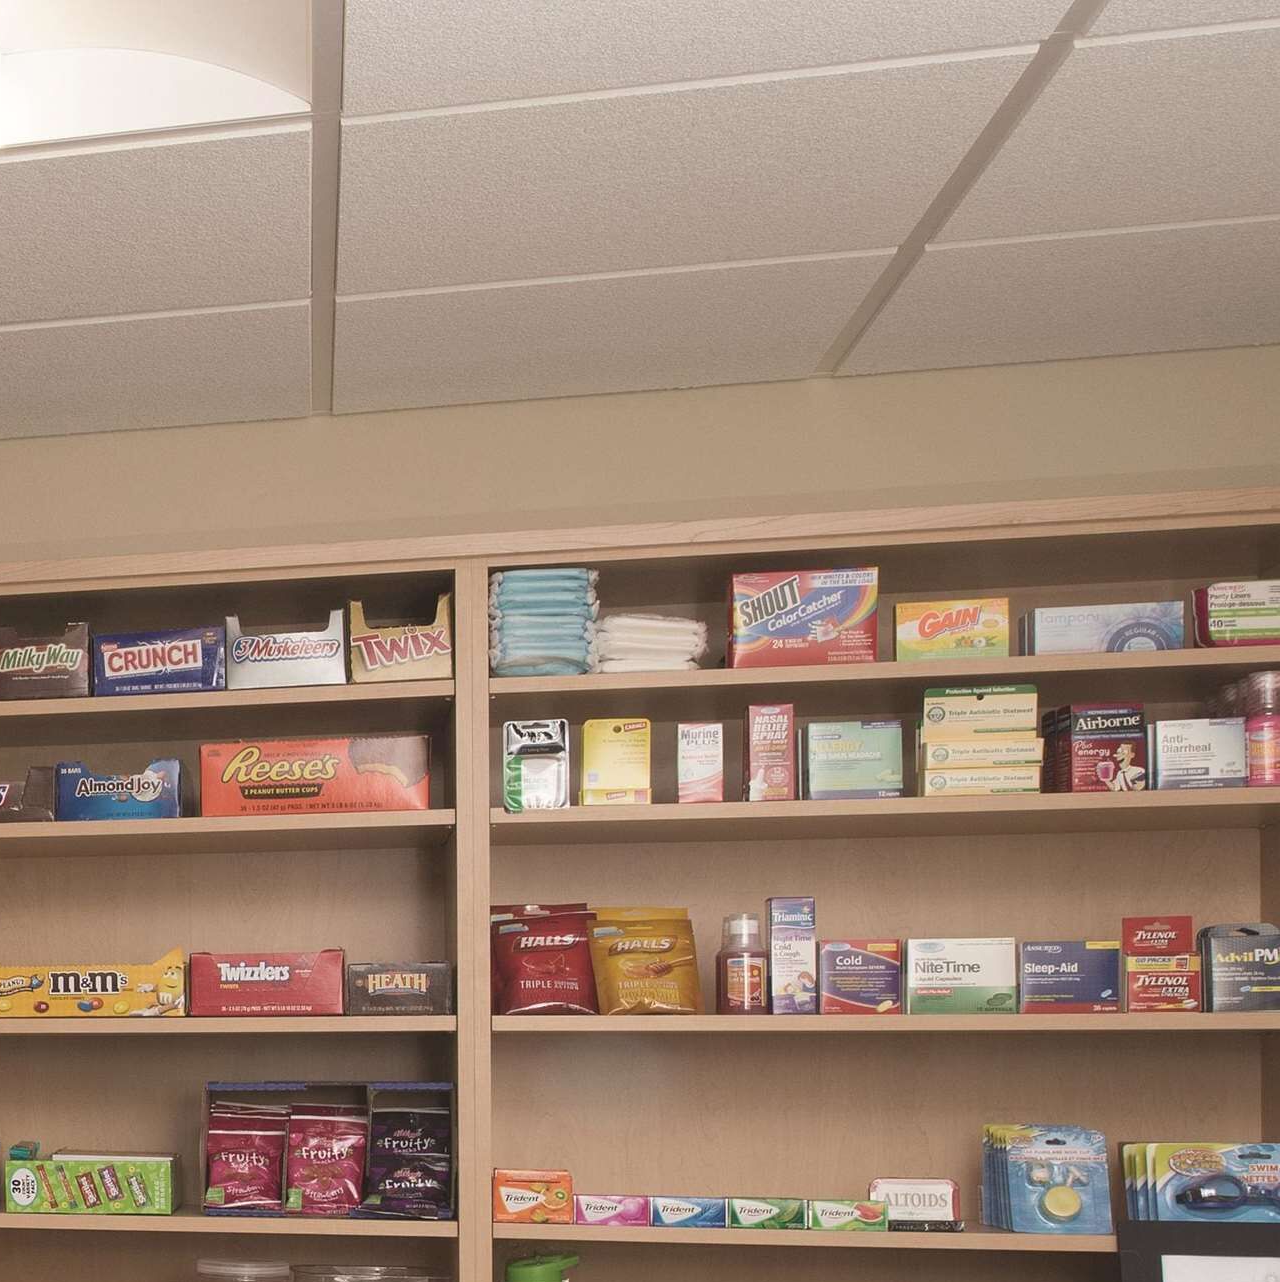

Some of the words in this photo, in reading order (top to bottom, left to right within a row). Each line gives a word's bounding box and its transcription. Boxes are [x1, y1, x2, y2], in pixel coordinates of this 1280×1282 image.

[740, 577, 800, 627] SHOUT
[1210, 593, 1229, 602] Panty
[1231, 591, 1252, 600] Liners
[768, 590, 847, 631] ColorCatcher
[917, 606, 981, 640] GAIN
[1210, 619, 1224, 629] 40
[1124, 628, 1157, 639] REGULAR
[248, 637, 338, 661] Musketeers
[772, 639, 784, 648] 24
[106, 640, 200, 674] CRUNCH
[969, 708, 1002, 716] Antibiotic
[1003, 707, 1034, 715] Ointment
[755, 714, 789, 724] NASAL
[1075, 714, 1141, 732] Airborne
[753, 722, 788, 732] RELIEF
[681, 728, 719, 739] Murine
[752, 731, 788, 740] SPRAY
[1161, 735, 1189, 744] Anti-
[971, 747, 1003, 755] Antibiotic
[1005, 746, 1035, 754] Ointment
[1073, 740, 1094, 752] Plus
[1161, 743, 1212, 754] Diarrheal
[1078, 748, 1111, 757] energy
[221, 745, 340, 784] Reese's
[949, 776, 968, 784] Triple
[969, 775, 1002, 783] Antibiotic
[1003, 774, 1034, 782] Ointment
[76, 776, 134, 797] Almond
[134, 774, 162, 801] Joy
[771, 911, 814, 923] Triaminic
[519, 935, 575, 949] HALLS
[773, 934, 792, 944] Night
[794, 934, 812, 942] Time
[1133, 930, 1177, 944] TYLENOL
[615, 937, 673, 951] HALLS
[773, 943, 792, 952] Cold
[835, 955, 863, 966] Cold
[1215, 952, 1254, 965] Advil
[1254, 948, 1279, 963] PM
[217, 961, 291, 983] Twizzlers
[914, 961, 981, 975] NiteTime
[1024, 963, 1079, 978] Sleep-Aid
[368, 973, 428, 994] HEATH
[520, 980, 552, 990] TRIPLE
[915, 976, 934, 984] Liquid
[935, 975, 963, 983] Capsules
[1134, 975, 1189, 991] TYLENOL
[618, 981, 649, 990] TRIPLE
[1161, 987, 1189, 995] EXTRA
[1249, 1164, 1278, 1172] SWIM
[504, 1193, 541, 1204] Trident
[884, 1191, 949, 1209] ALTOIDS
[583, 1202, 620, 1214] Trident
[660, 1204, 697, 1216] Trident
[737, 1206, 774, 1218] Trident
[819, 1208, 856, 1219] Trident
